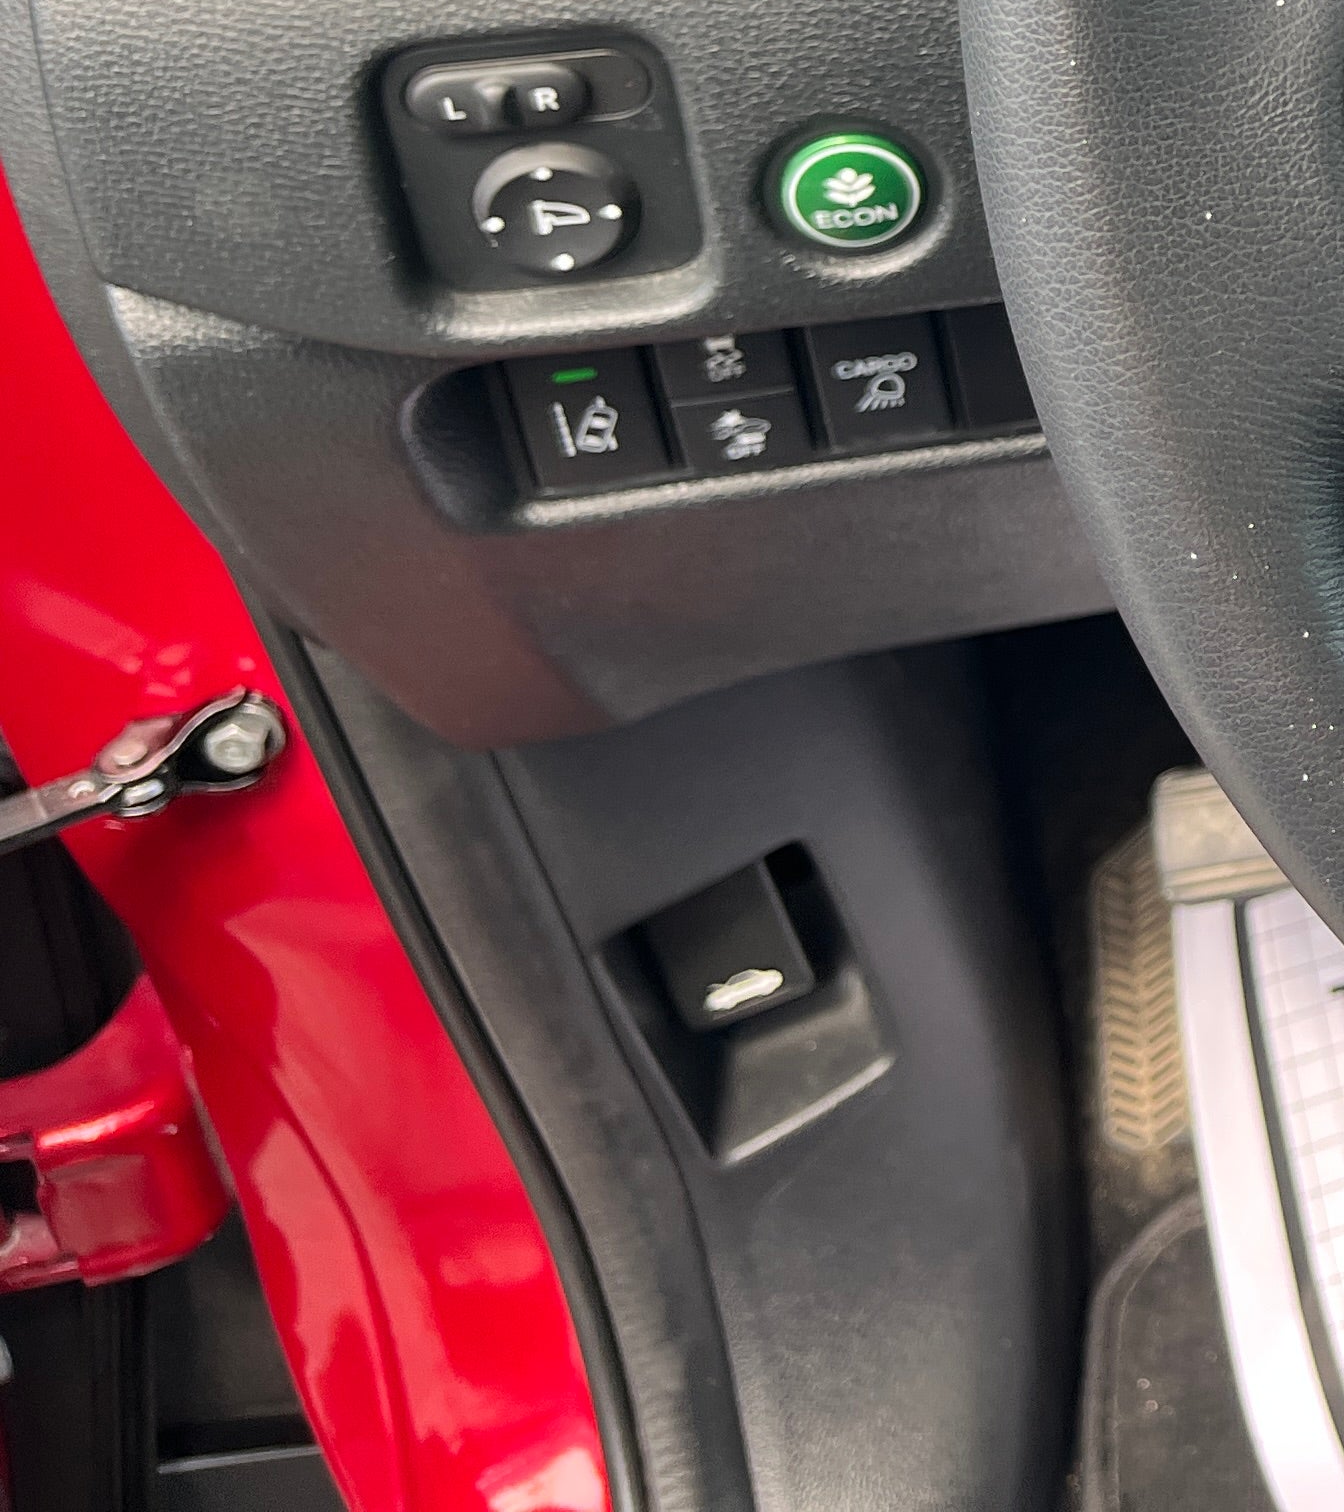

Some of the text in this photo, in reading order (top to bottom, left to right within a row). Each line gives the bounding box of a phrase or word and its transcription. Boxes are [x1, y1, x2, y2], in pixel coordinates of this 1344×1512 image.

[441, 96, 467, 121] L
[529, 87, 561, 113] R
[814, 202, 899, 230] ECON
[832, 351, 918, 381] CARGO
